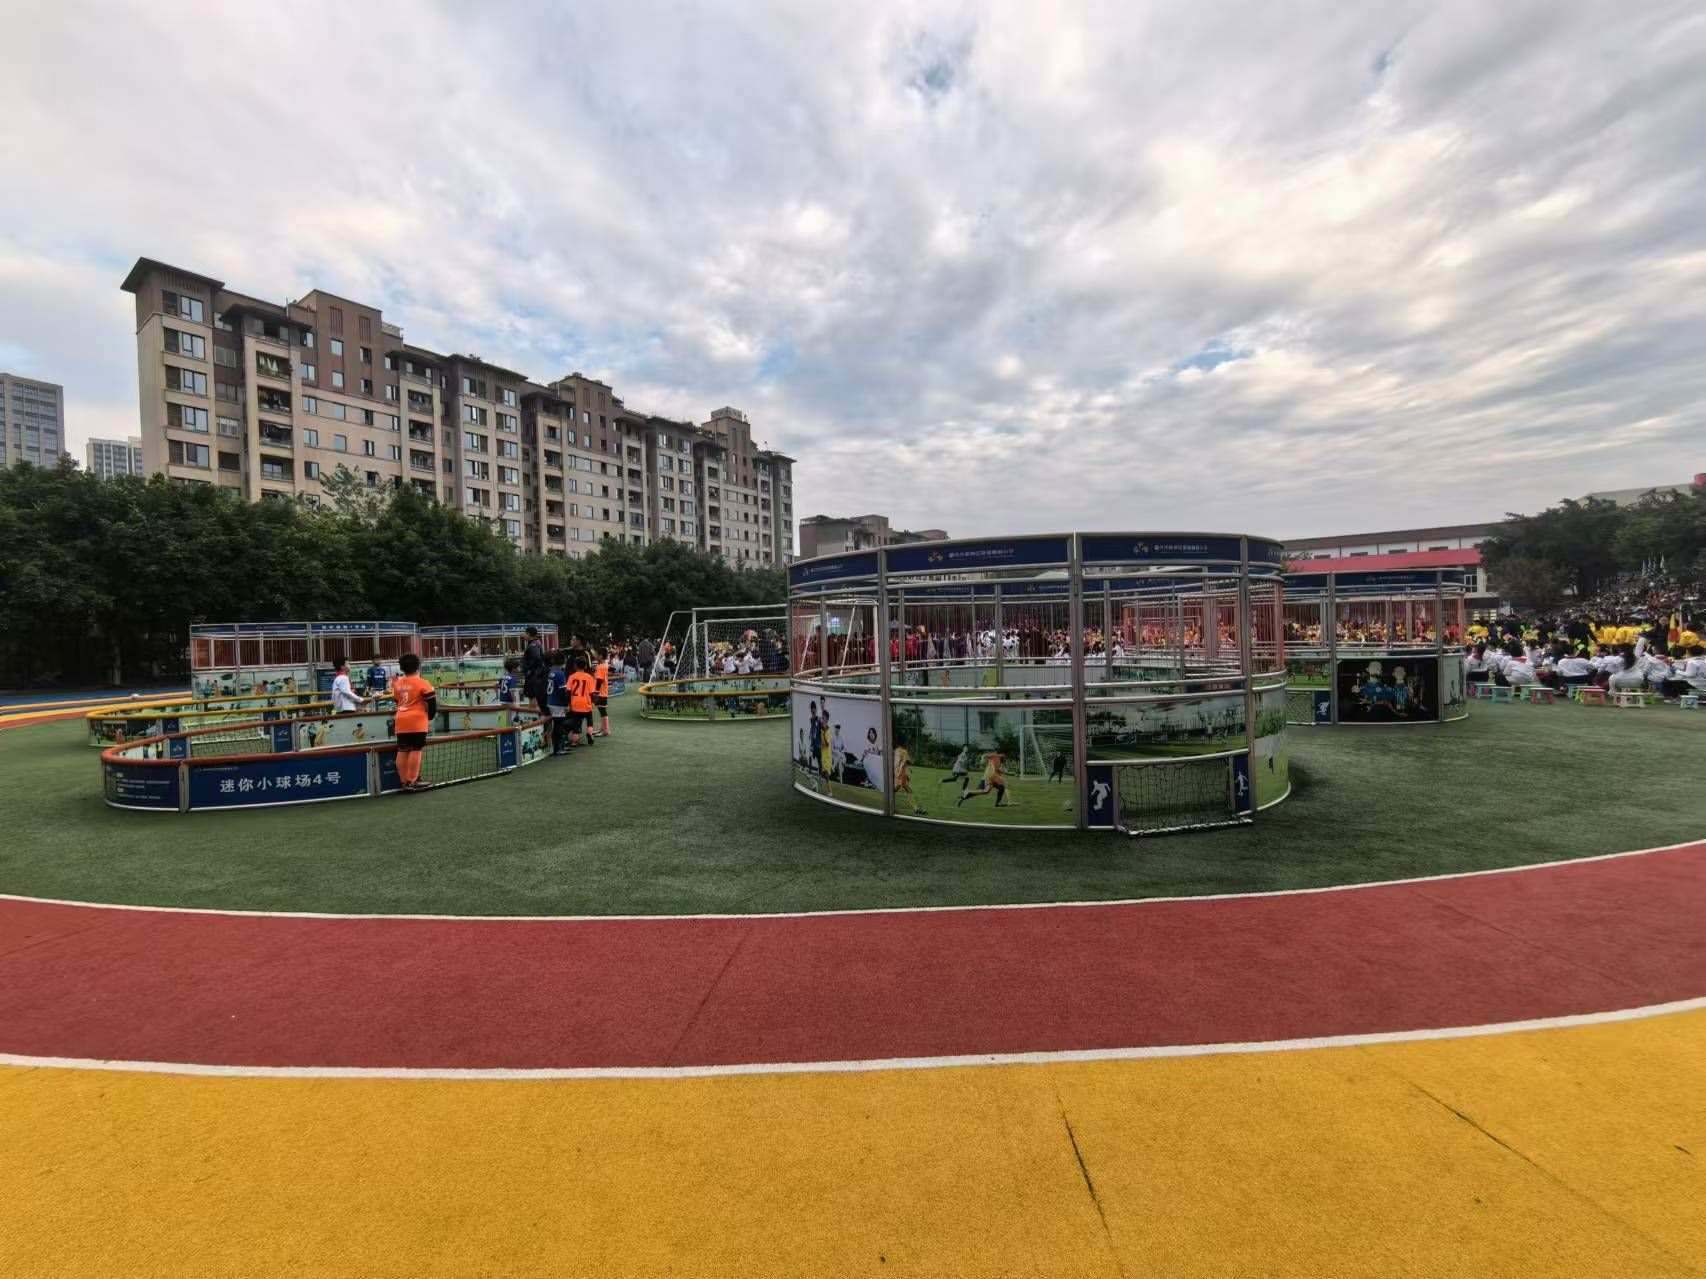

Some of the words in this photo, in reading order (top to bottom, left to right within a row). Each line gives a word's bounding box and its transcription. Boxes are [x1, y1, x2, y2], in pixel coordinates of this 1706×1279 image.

[572, 679, 587, 697] 21
[220, 771, 341, 793] 迷你小球场4号
